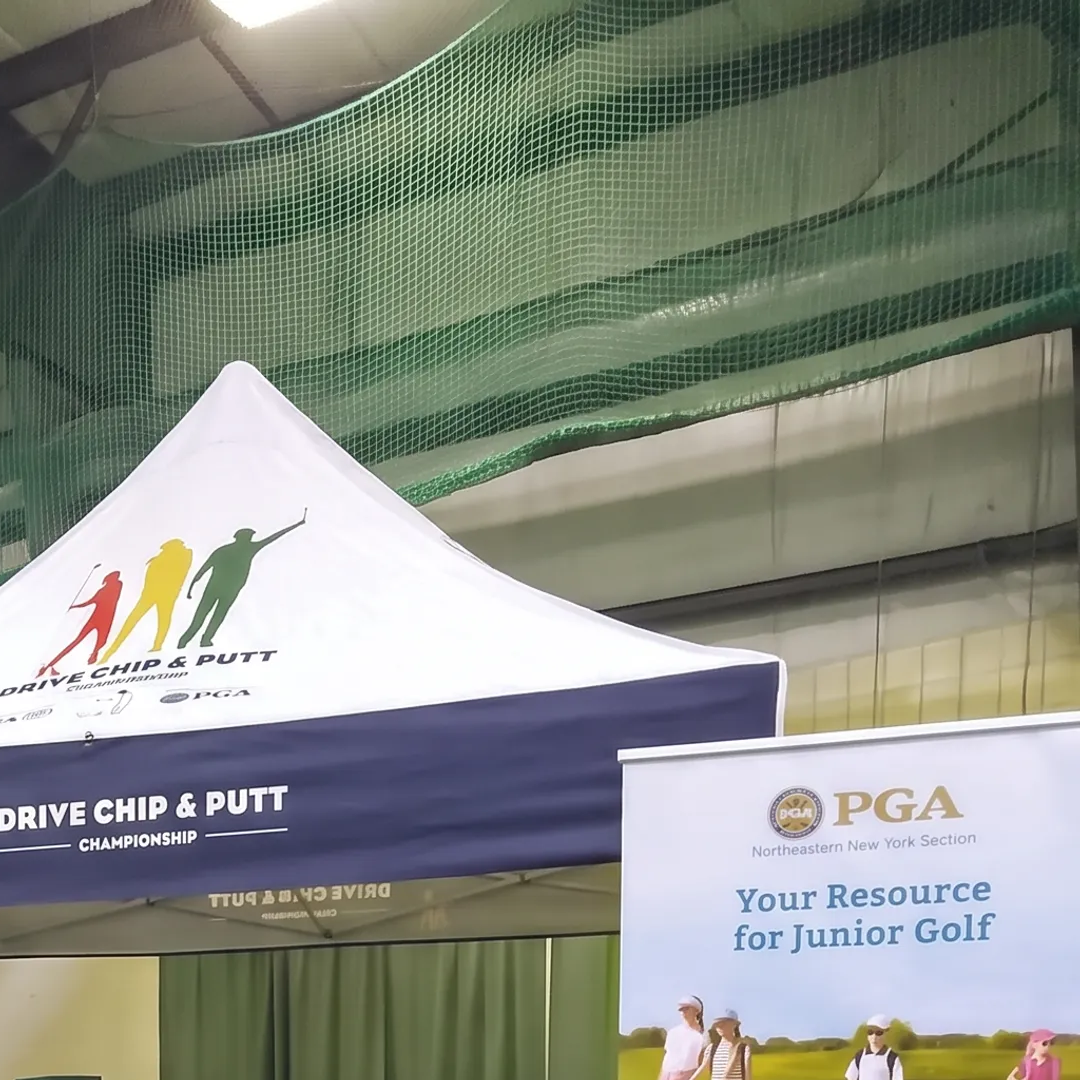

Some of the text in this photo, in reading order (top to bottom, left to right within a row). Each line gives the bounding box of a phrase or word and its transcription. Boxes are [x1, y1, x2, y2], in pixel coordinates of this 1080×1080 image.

[89, 657, 162, 682] CHIP
[167, 655, 188, 669] &
[195, 650, 278, 667] PUTT
[192, 689, 251, 701] PGA
[92, 795, 169, 826] CHIP
[175, 792, 197, 819] &
[204, 785, 289, 817] PUTT
[832, 785, 964, 827] PGA
[78, 830, 198, 853] CHAMPIONSHIP
[752, 832, 977, 858] Northeastern New York Section
[735, 880, 992, 914] Your Resource
[733, 912, 996, 954] for Junior Golf
